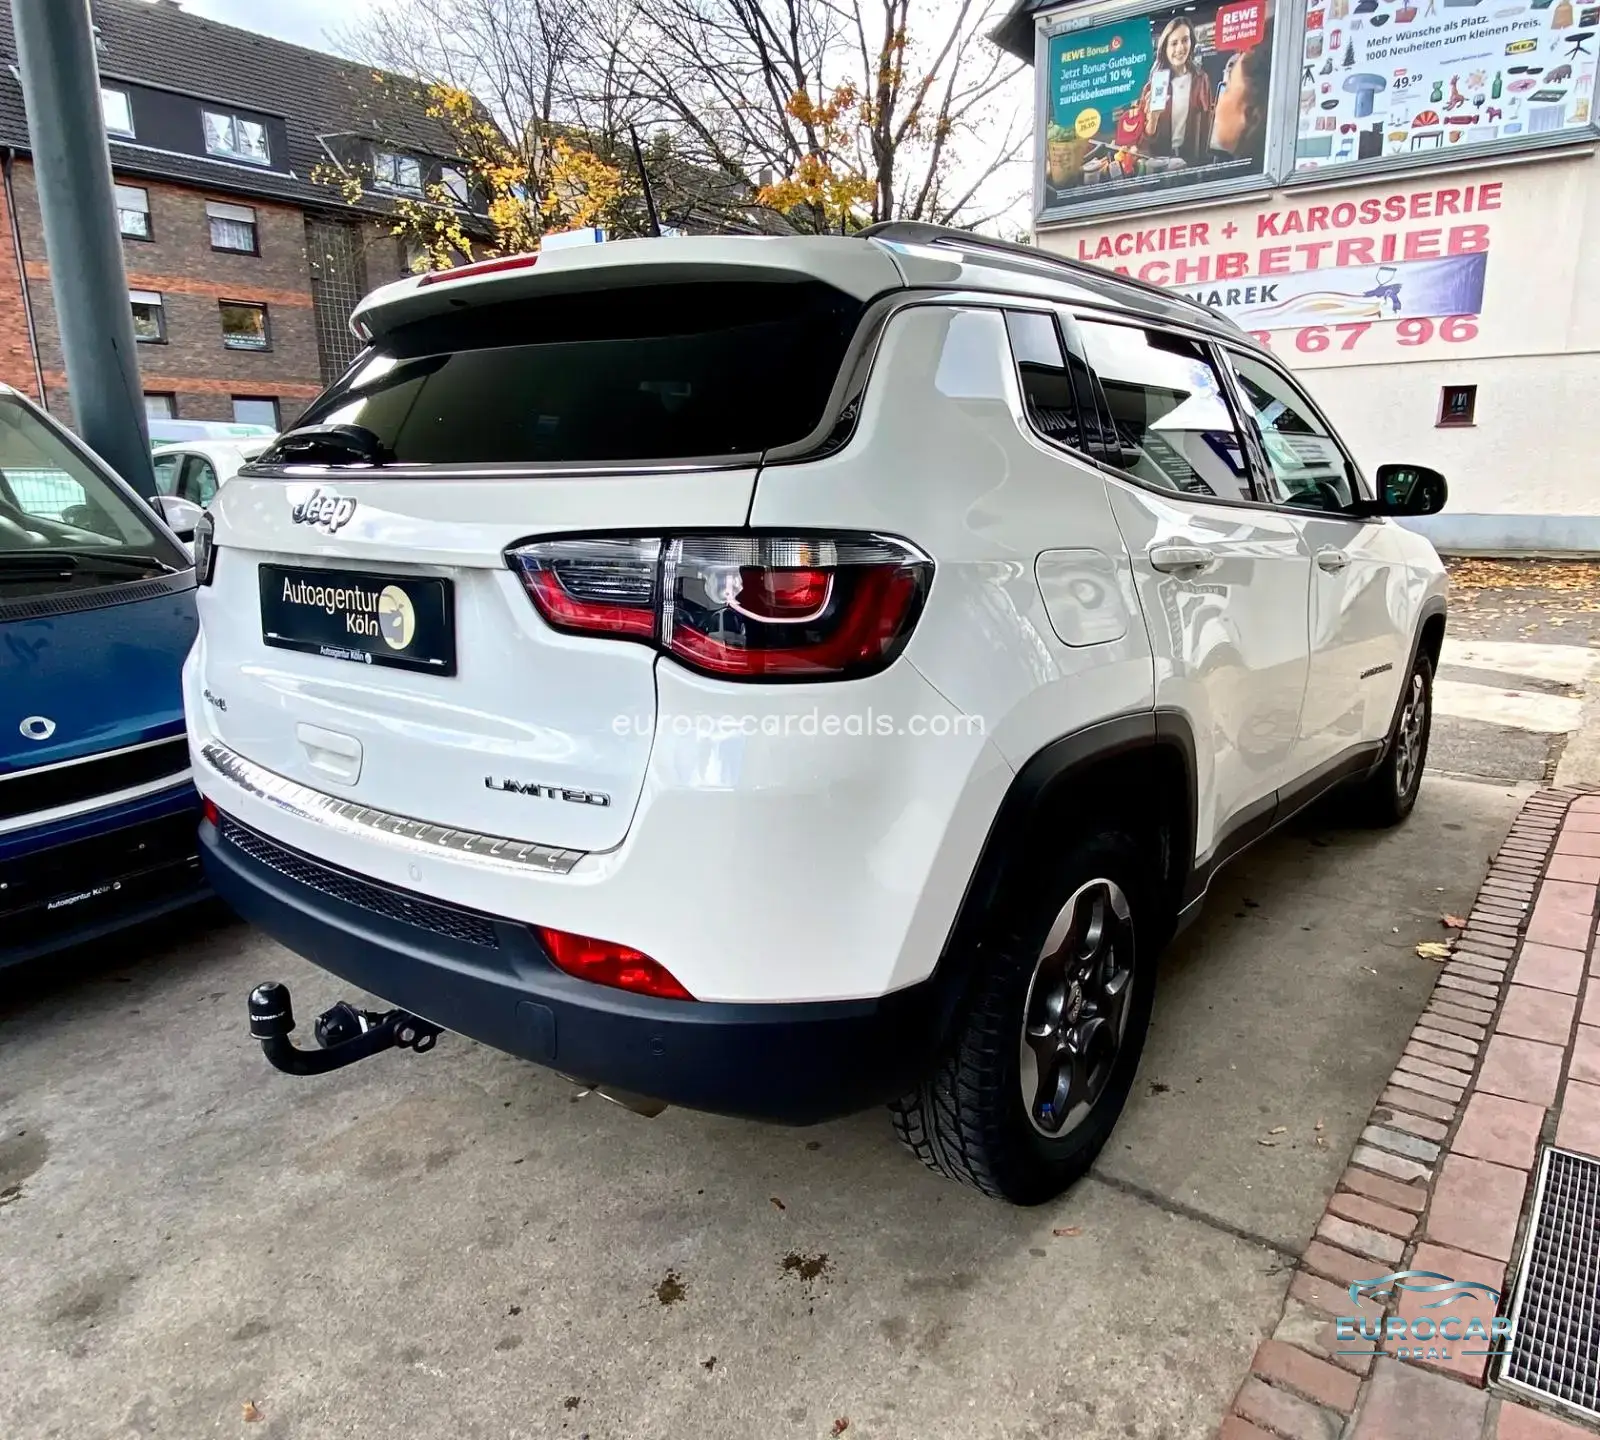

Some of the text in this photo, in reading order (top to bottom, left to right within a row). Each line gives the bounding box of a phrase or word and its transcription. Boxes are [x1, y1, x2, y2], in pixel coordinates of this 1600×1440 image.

[1223, 6, 1258, 26] REWE
[1366, 15, 1489, 48] Mehr Wünsche als Platz.
[1366, 18, 1541, 61] 1000 Neuheiten zum kleinen Preis.
[1508, 41, 1534, 52] IKEA
[1060, 53, 1147, 80] Jetzt Bonus-Guthaben
[1061, 45, 1109, 63] REWE Bonus
[1060, 79, 1090, 93] einlösen
[1092, 73, 1107, 86] und
[1079, 182, 1503, 261] LACKIER + KAROSSERIE
[1295, 321, 1374, 353] 67
[1396, 313, 1479, 346] 96
[292, 488, 358, 534] Jeep
[282, 576, 380, 615] Autoagentur
[346, 611, 379, 637] Köln
[320, 645, 365, 662] Autoagentur Köln
[484, 775, 611, 808] LIMITED
